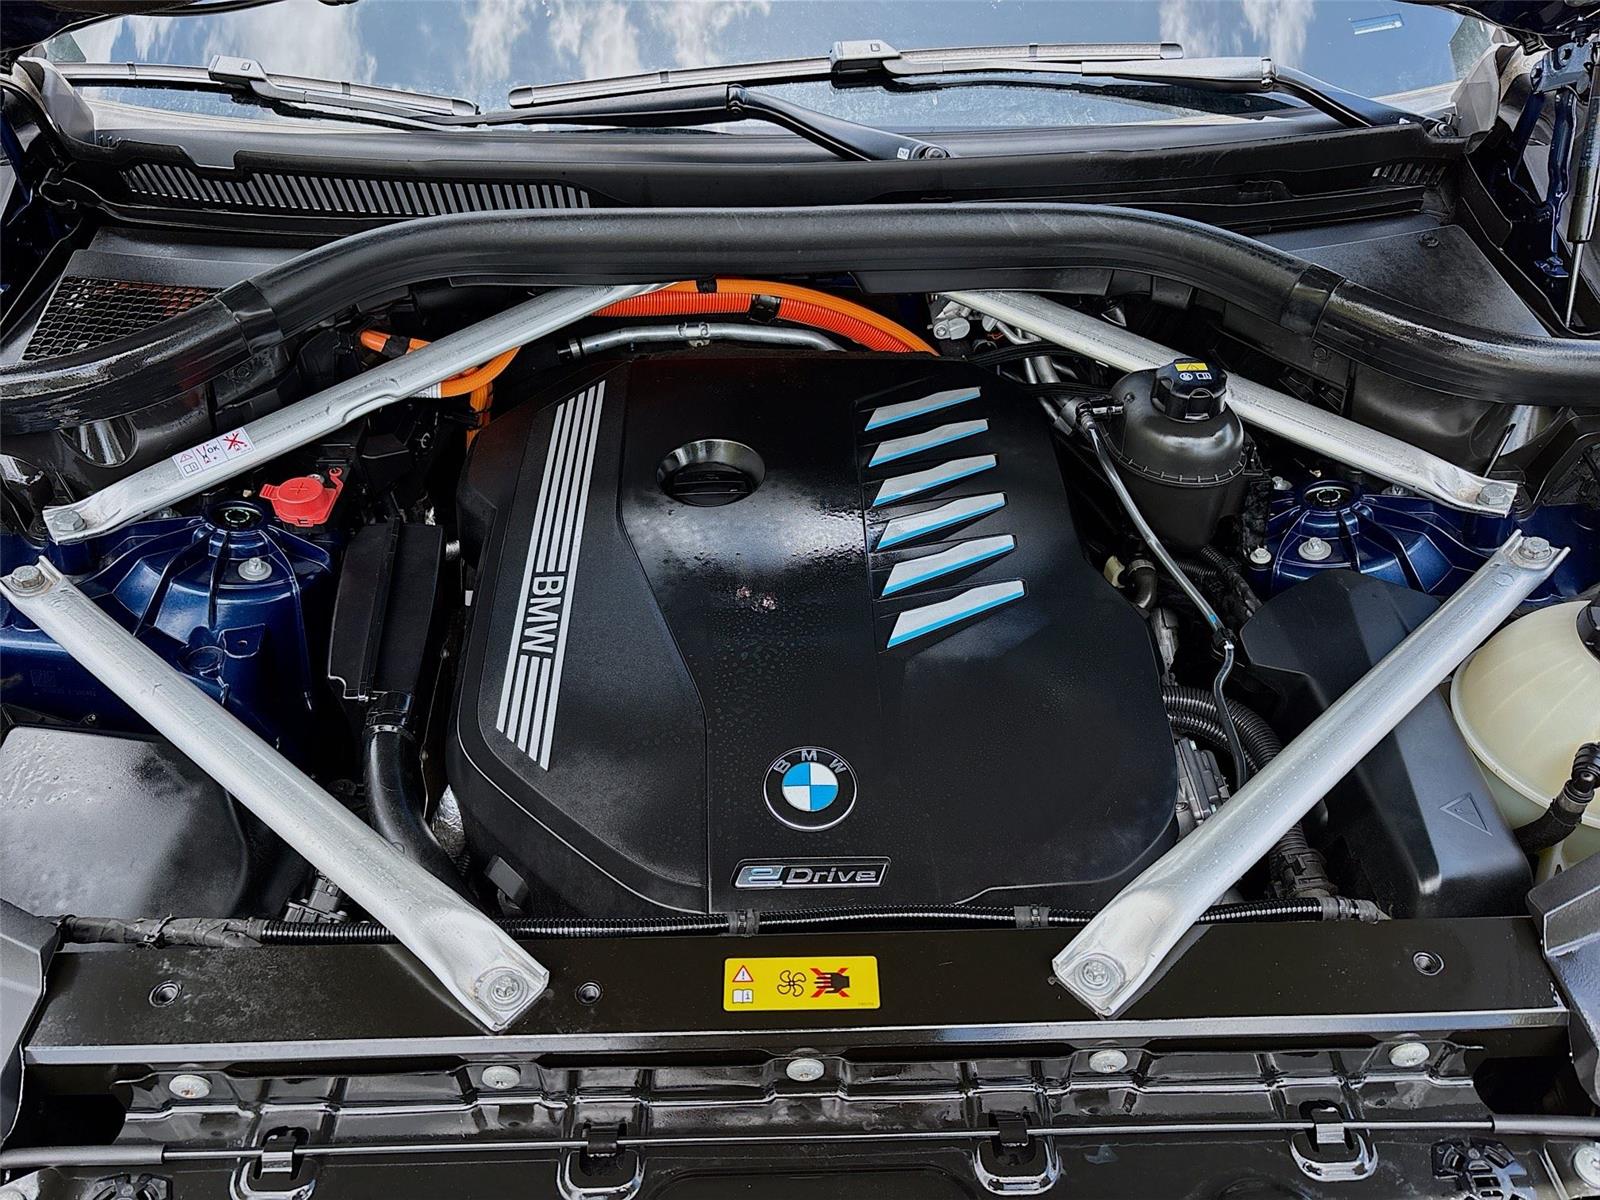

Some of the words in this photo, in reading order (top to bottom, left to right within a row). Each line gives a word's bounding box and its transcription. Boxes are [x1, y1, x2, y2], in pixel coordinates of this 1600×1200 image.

[207, 445, 220, 454] OK
[521, 575, 565, 654] BMW
[773, 750, 847, 774] BMW
